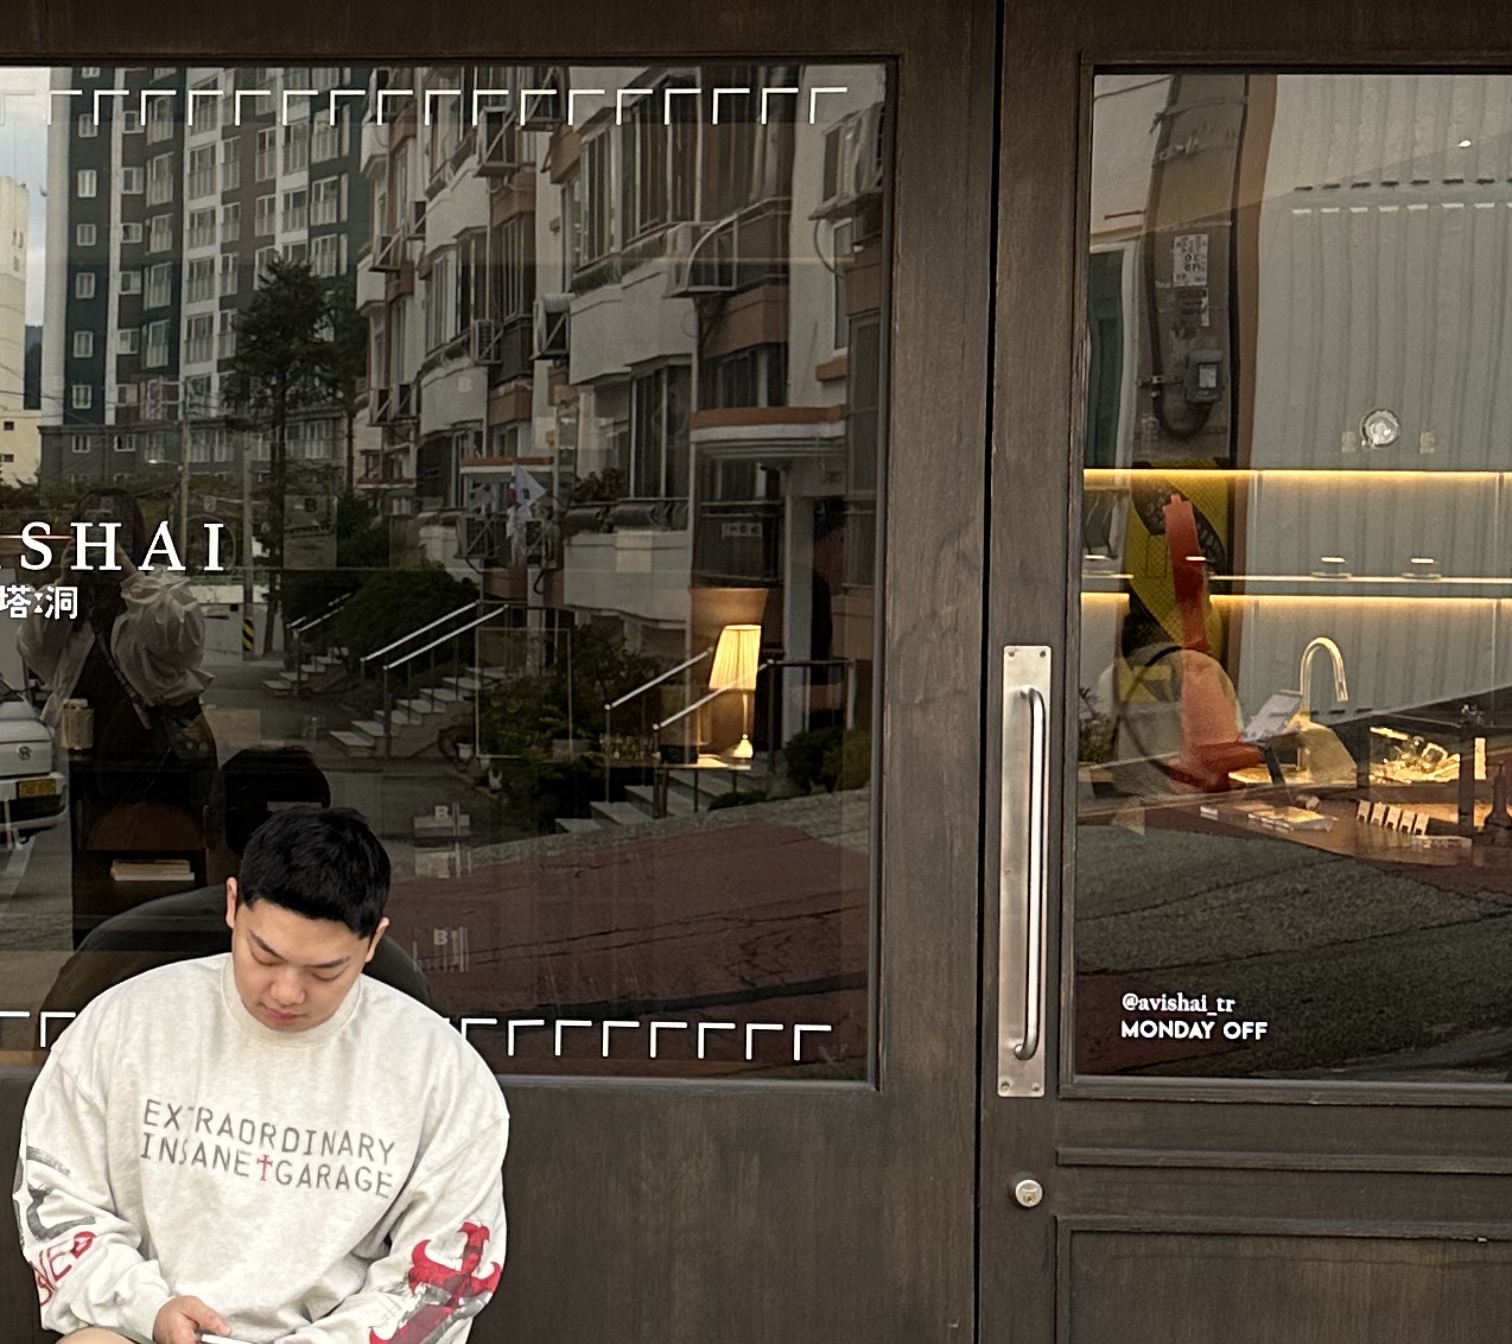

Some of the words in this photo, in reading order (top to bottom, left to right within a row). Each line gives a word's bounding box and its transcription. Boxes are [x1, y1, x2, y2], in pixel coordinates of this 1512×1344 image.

[1122, 991, 1236, 1016] @avishai_tr
[1121, 1020, 1215, 1039] MONDAY
[1223, 1021, 1268, 1040] OFF
[143, 1098, 395, 1166] EXRAORDINARY
